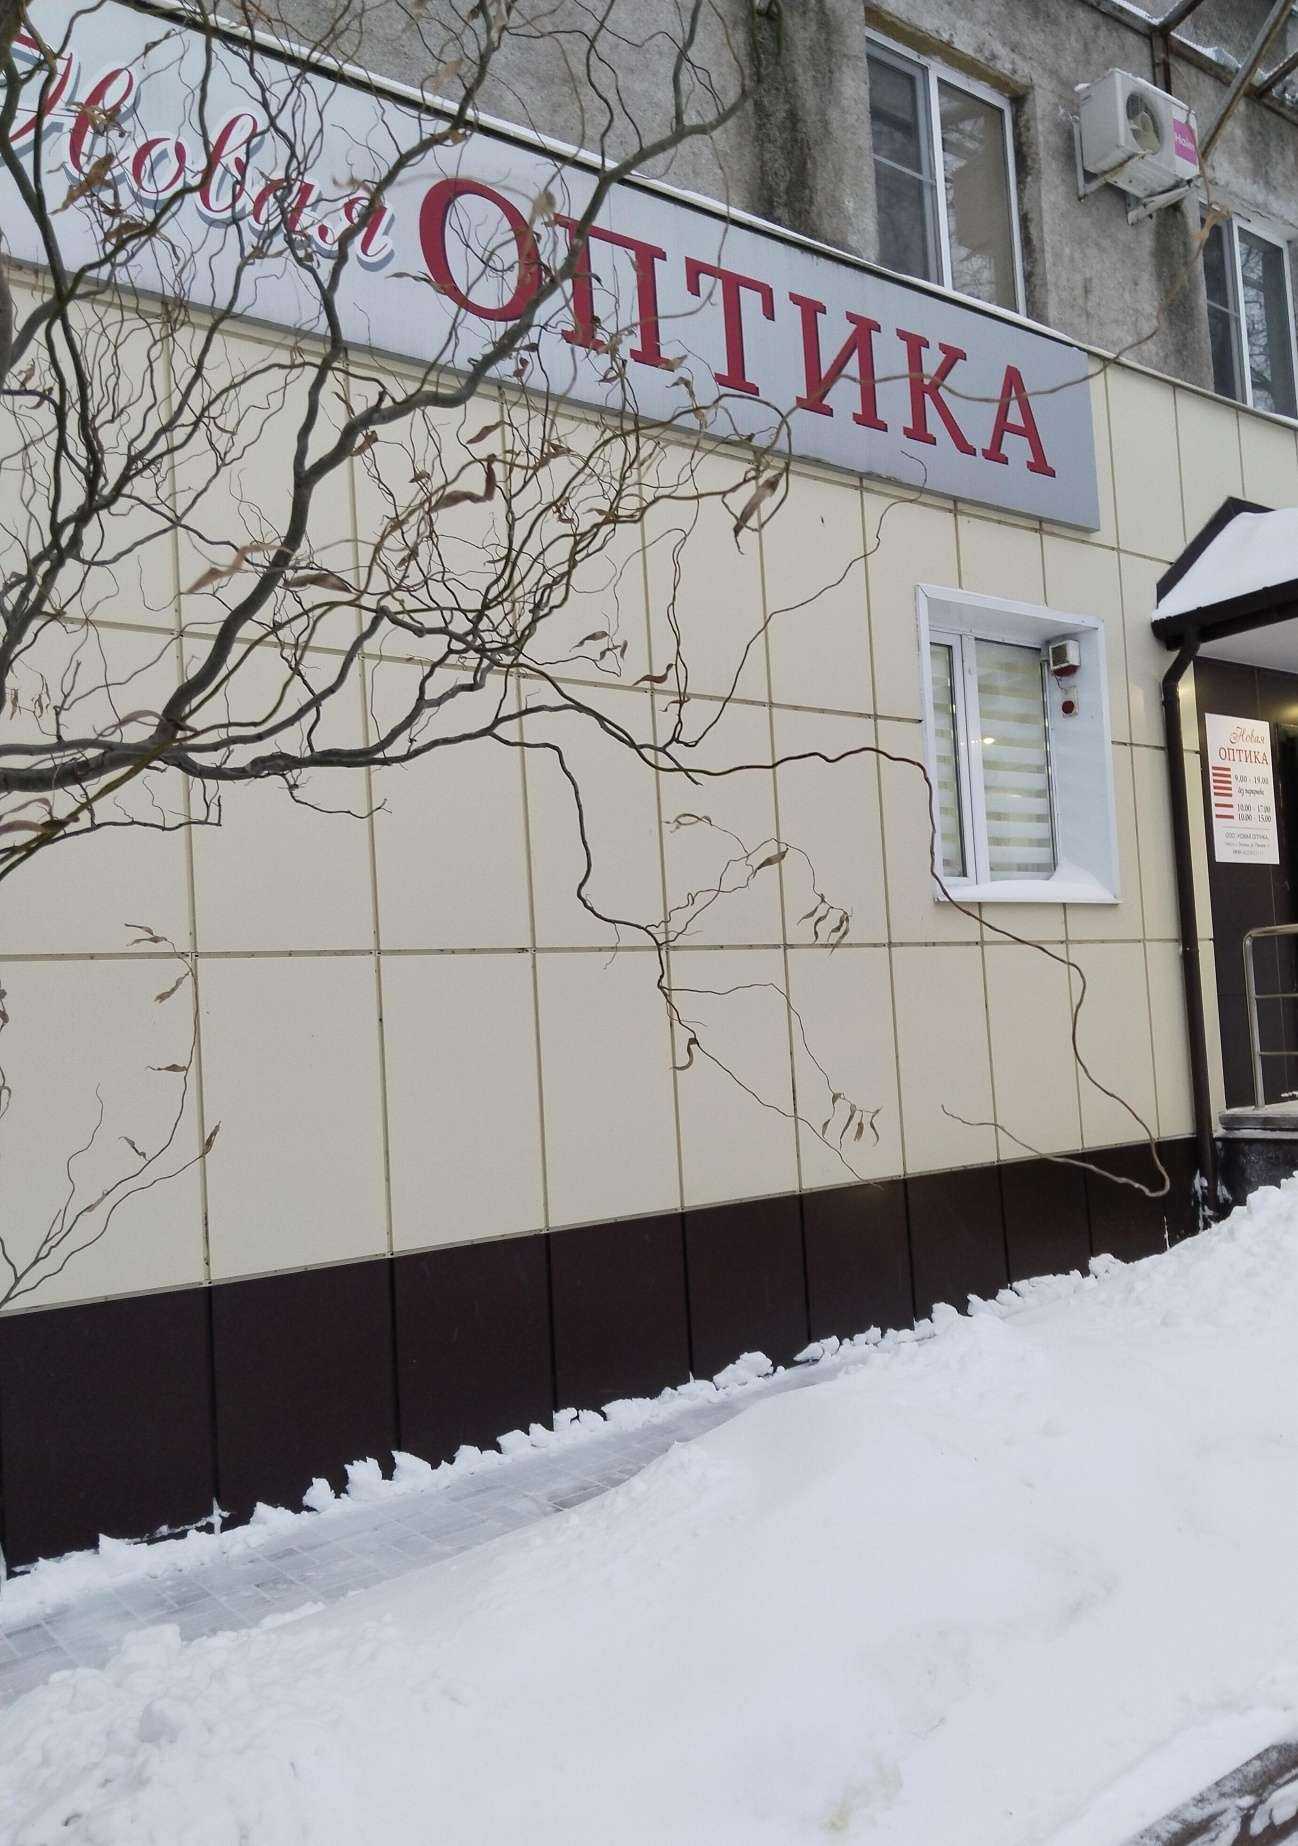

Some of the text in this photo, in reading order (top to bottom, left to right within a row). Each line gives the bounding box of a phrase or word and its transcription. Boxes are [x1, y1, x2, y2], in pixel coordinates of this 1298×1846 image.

[419, 178, 1056, 478] ОПТИКА
[1229, 726, 1265, 744] Новая
[1218, 747, 1269, 765] ОПТИКА
